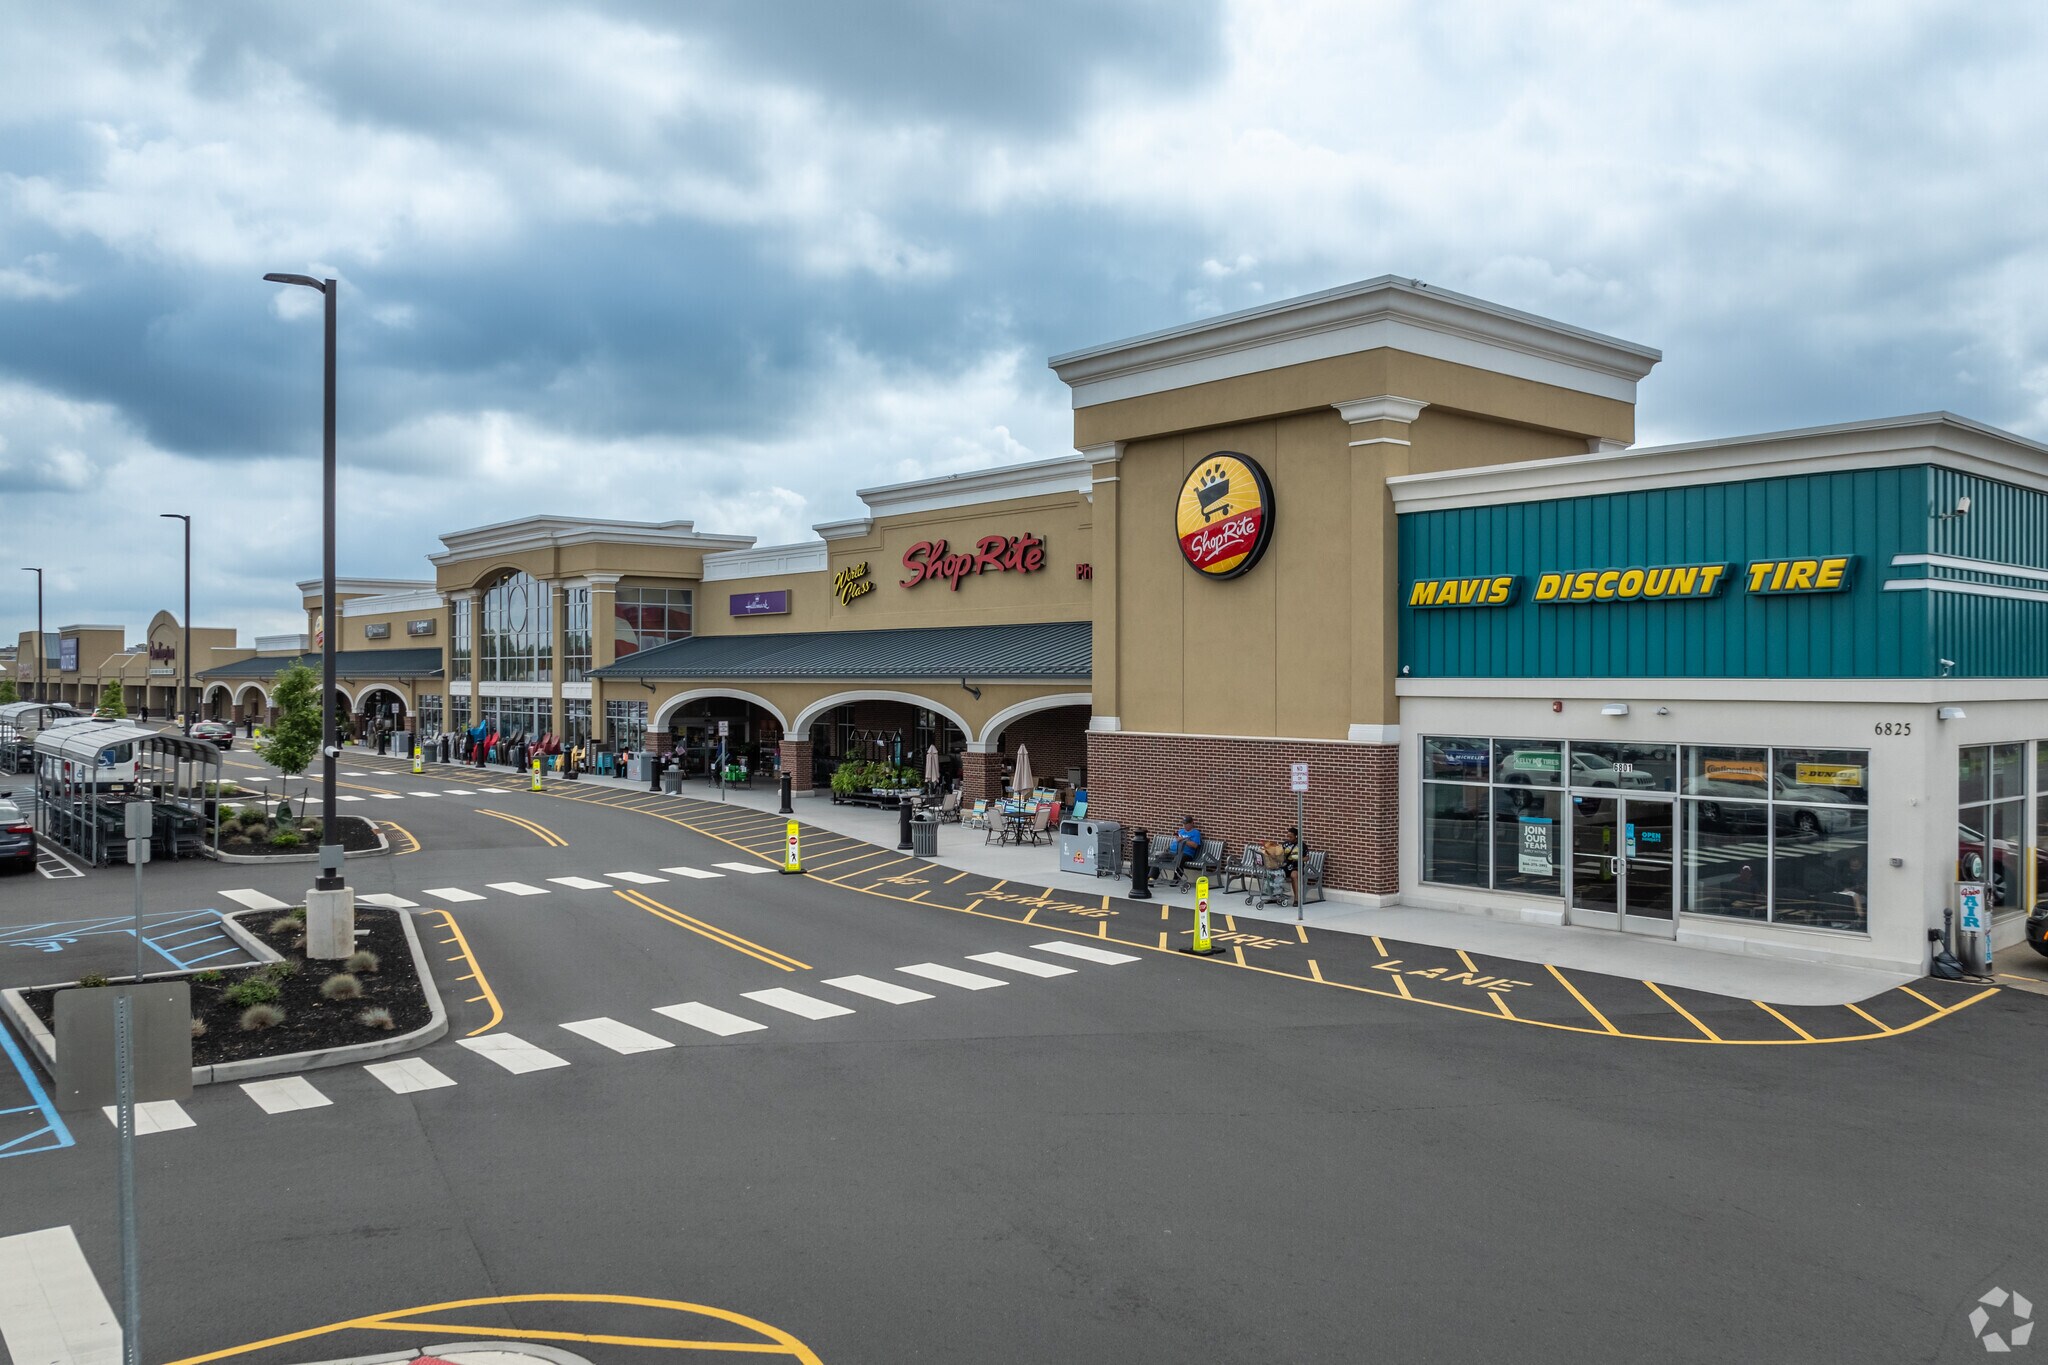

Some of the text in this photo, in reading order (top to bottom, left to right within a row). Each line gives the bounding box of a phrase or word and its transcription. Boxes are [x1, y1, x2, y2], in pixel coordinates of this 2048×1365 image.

[1191, 516, 1256, 562] ShopRite
[899, 532, 1045, 592] ShopRite
[834, 561, 868, 596] World
[1407, 558, 1848, 606] MAVIS DISCOUNT TIRE
[841, 580, 871, 607] Class
[745, 600, 770, 614] Hallmark
[1875, 722, 1911, 736] 6825
[1515, 757, 1560, 766] KELLY TIRES
[1614, 763, 1632, 772] 6801
[1706, 763, 1752, 774] Continental
[1809, 770, 1857, 779] DUNLOP
[1524, 825, 1546, 836] JOIN
[1641, 831, 1661, 839] OPEN
[1524, 841, 1547, 850] TEAM
[1525, 834, 1546, 843] OUR
[966, 889, 1120, 918] PARKING
[1963, 896, 1981, 928] AIR
[1371, 960, 1534, 992] LANE
